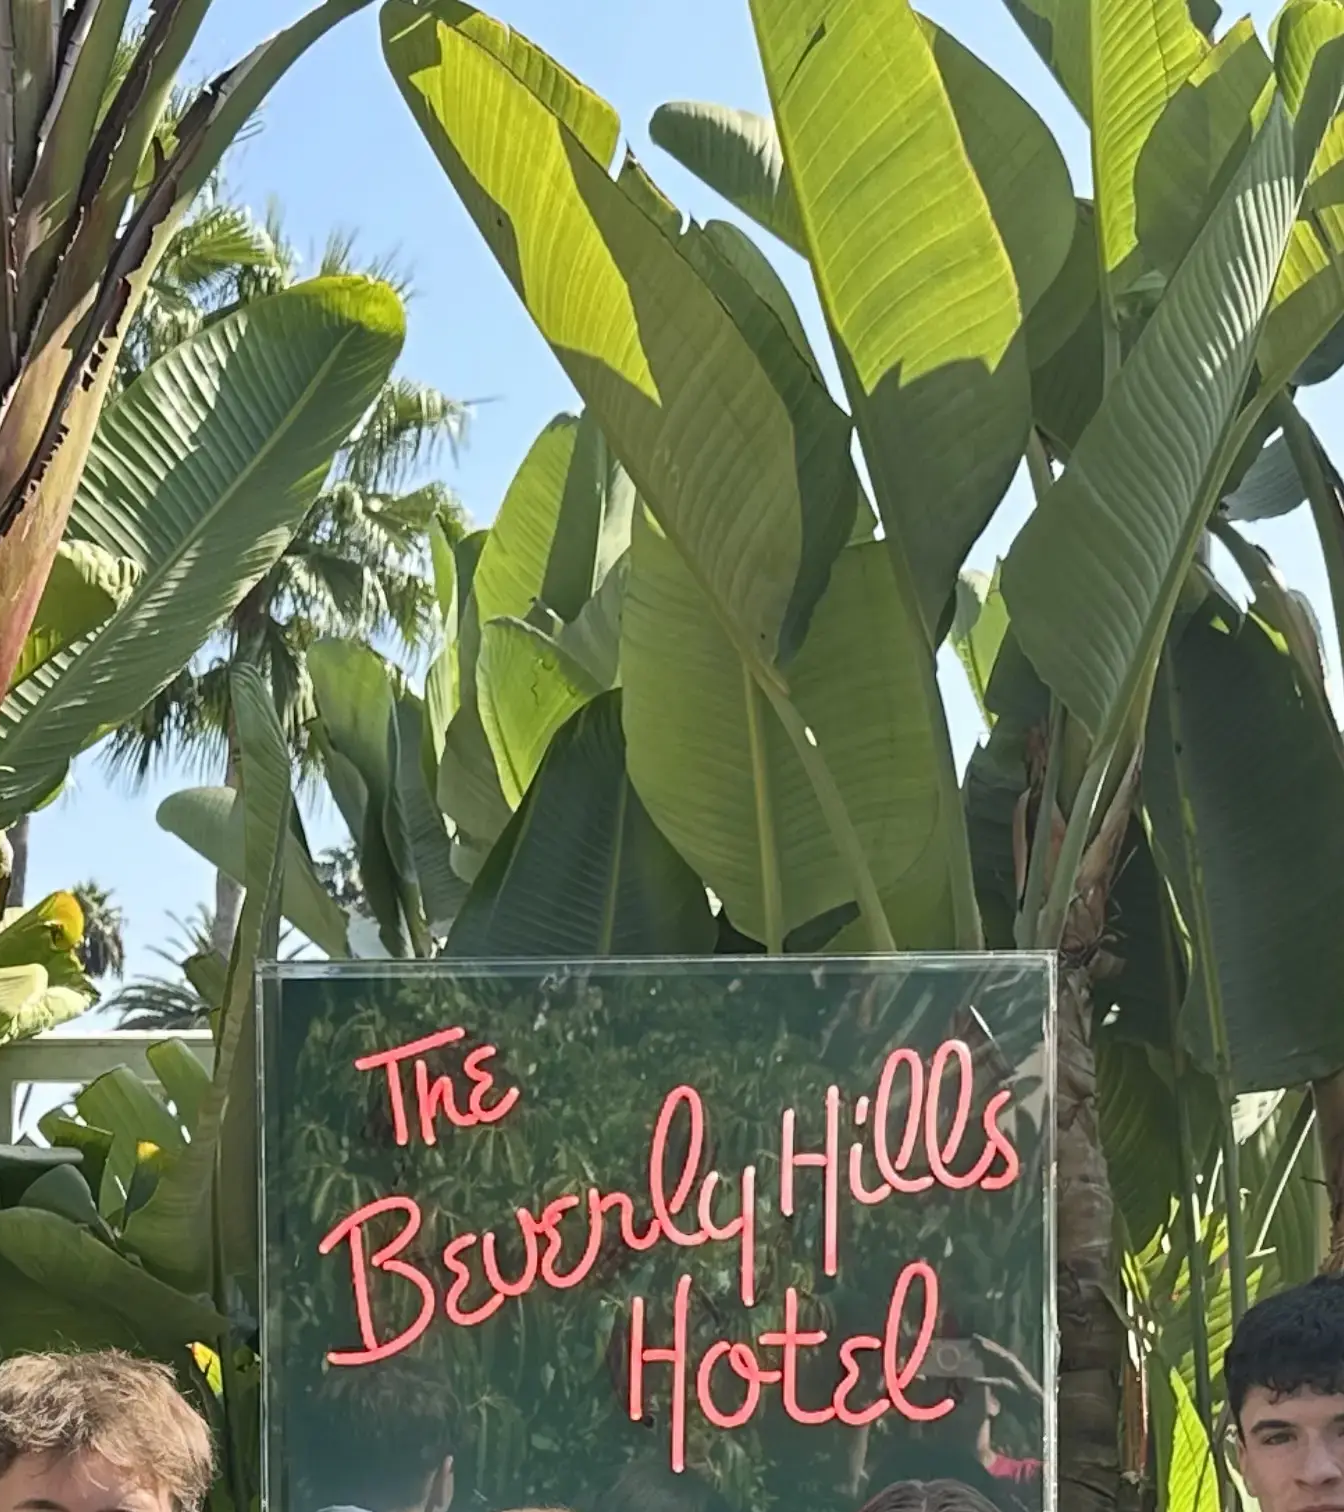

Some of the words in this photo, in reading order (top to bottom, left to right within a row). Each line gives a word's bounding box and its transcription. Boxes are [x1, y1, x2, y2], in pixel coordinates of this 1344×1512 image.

[354, 1026, 520, 1146] The
[318, 1084, 756, 1367] Beverly
[779, 1038, 1020, 1277] Hills
[627, 1259, 955, 1475] Hotel
